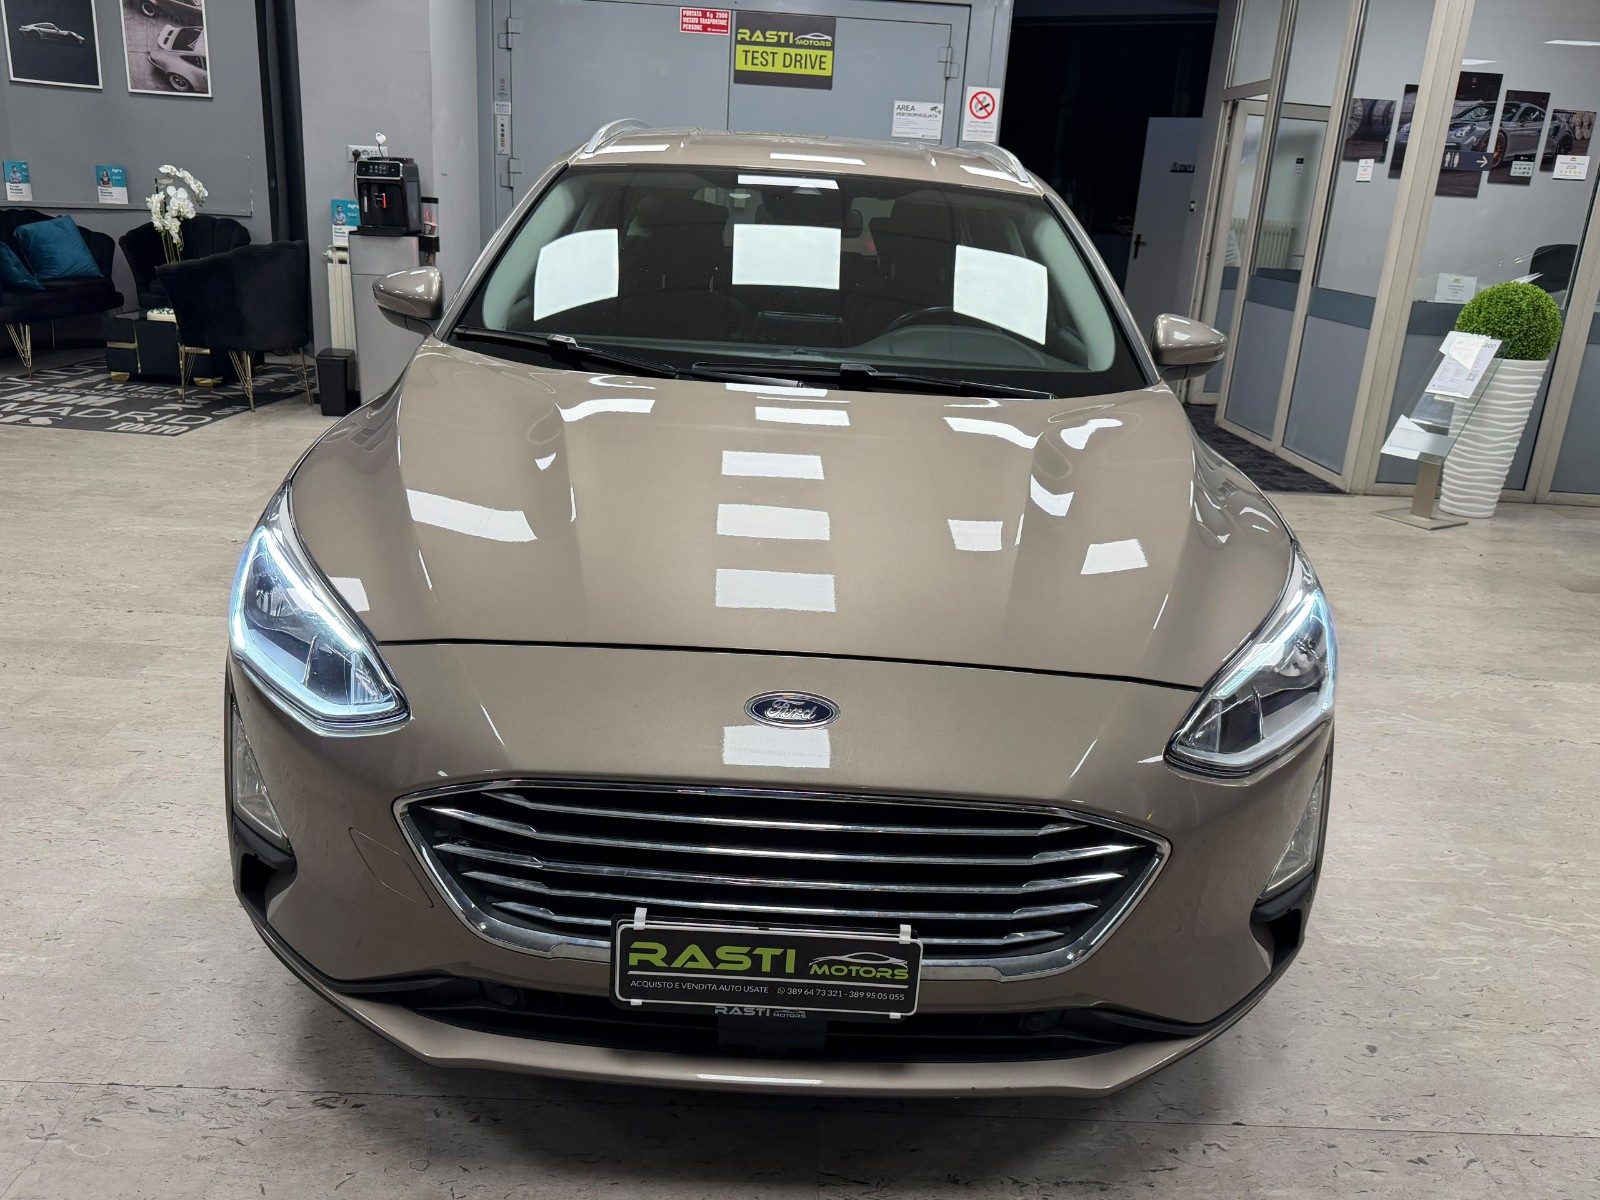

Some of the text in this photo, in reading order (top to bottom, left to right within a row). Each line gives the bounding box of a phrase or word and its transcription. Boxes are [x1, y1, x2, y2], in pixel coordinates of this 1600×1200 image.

[682, 23, 703, 31] PERSONE
[699, 18, 728, 26] TRASPORTARE
[737, 28, 794, 44] RASTI
[742, 50, 827, 70] TEST DRIVE
[95, 383, 198, 395] WIEN
[0, 391, 126, 407] ROM
[0, 402, 213, 425] MADRID
[105, 422, 190, 436] TOKYO
[764, 699, 818, 720] Ford
[628, 941, 909, 980] RASTI MOTORS
[630, 980, 673, 989] ACQUISTO
[681, 982, 717, 991] VENDITA
[719, 984, 742, 992] AUTO
[743, 985, 769, 994] USATE
[787, 987, 803, 995] 389
[803, 988, 814, 996] 64
[816, 989, 826, 997] 73
[827, 990, 842, 998] 321
[849, 991, 865, 999] 389
[877, 992, 888, 1000] 05
[889, 993, 905, 1001] 055
[714, 1005, 770, 1017] RASTI
